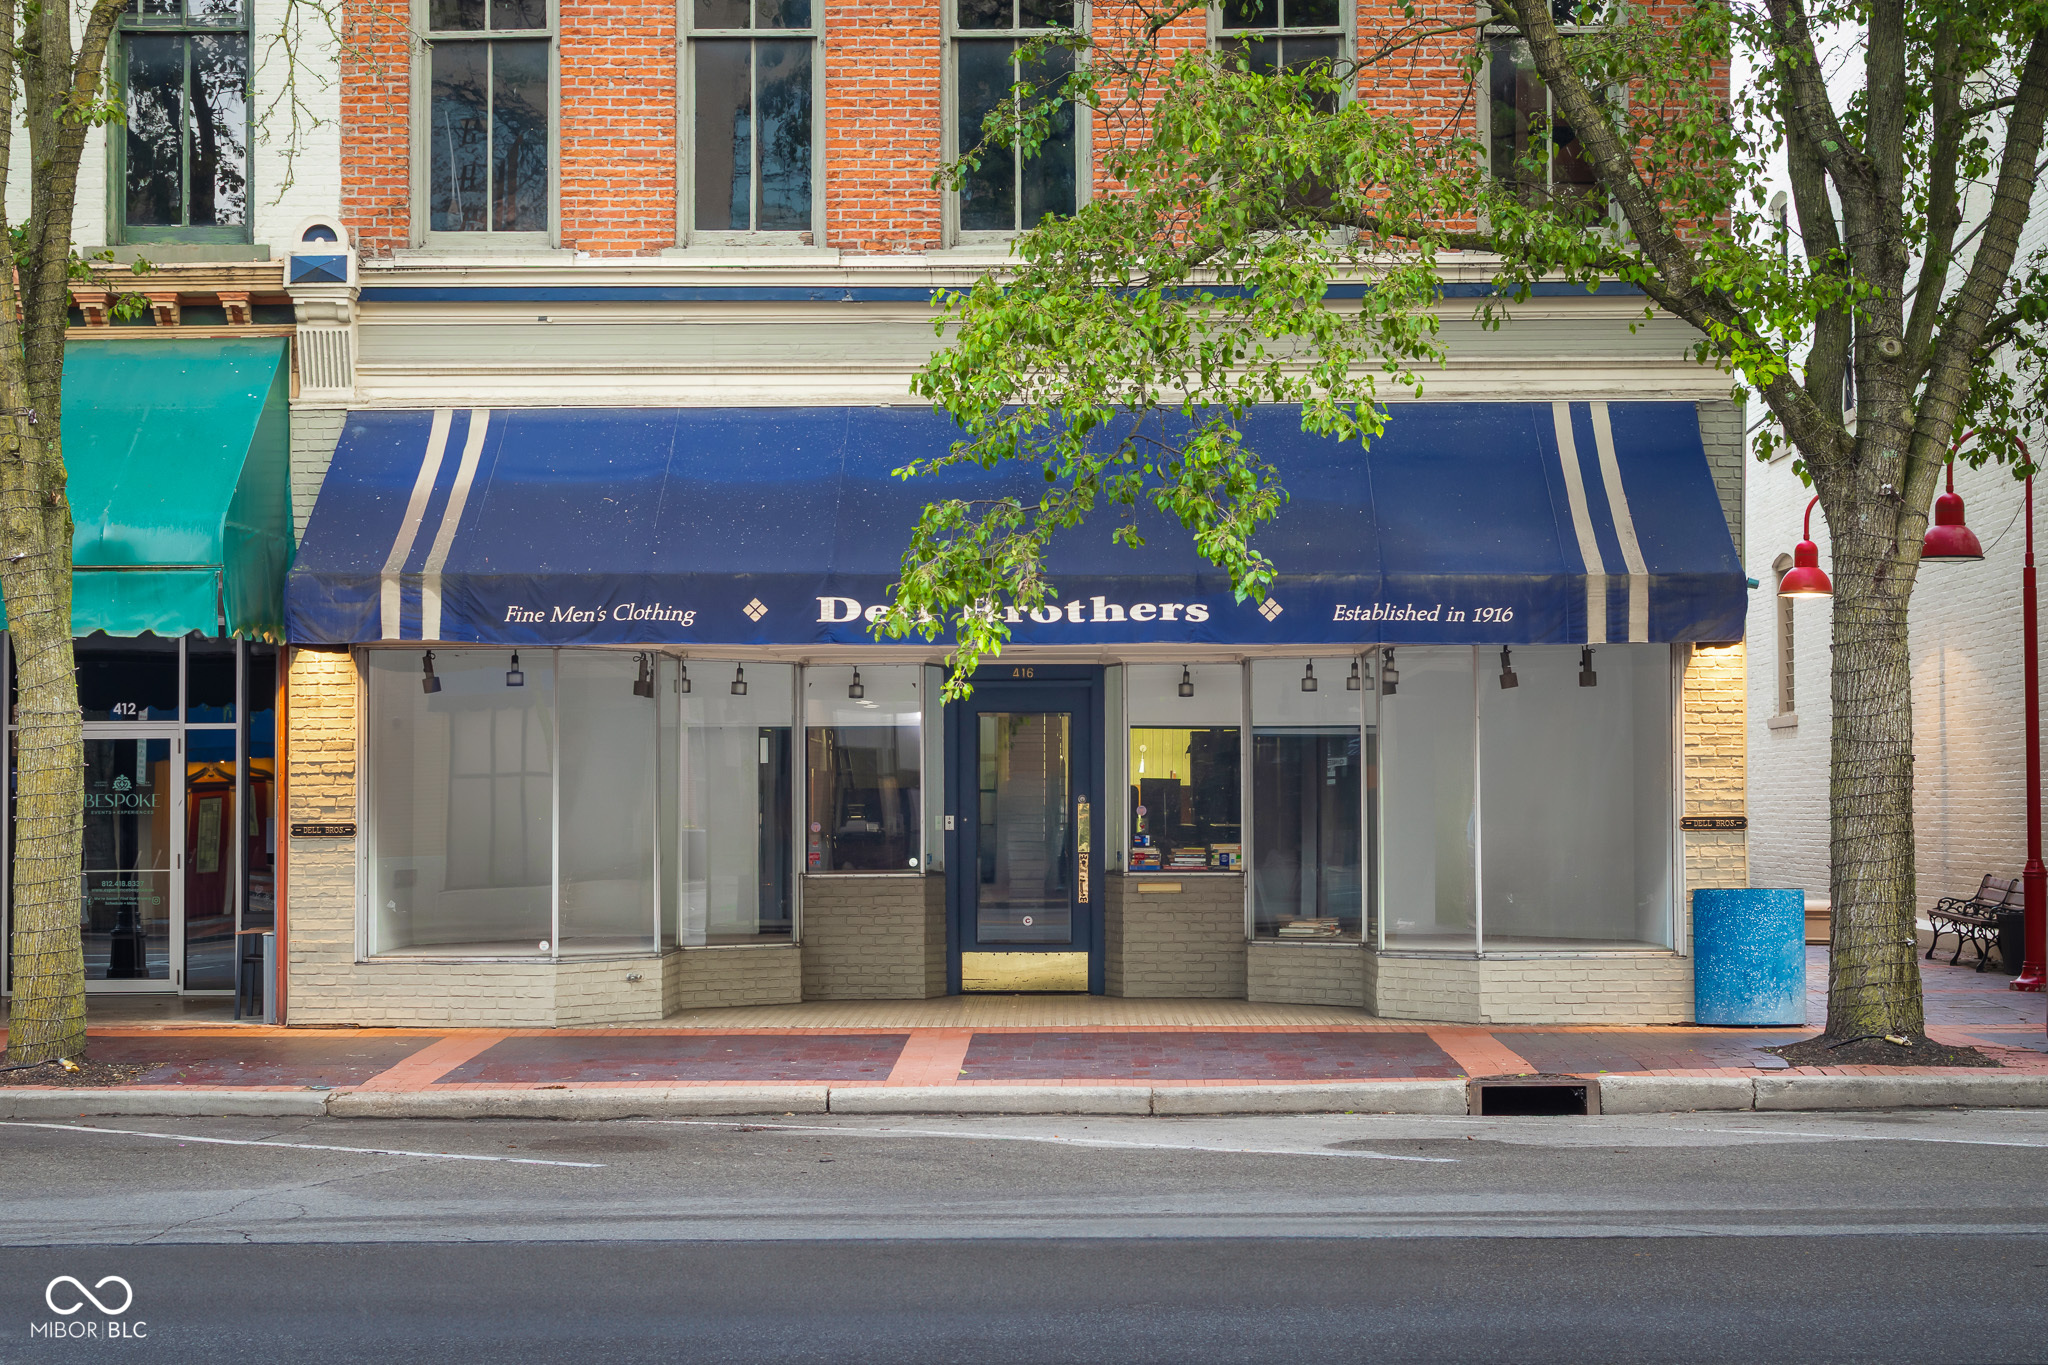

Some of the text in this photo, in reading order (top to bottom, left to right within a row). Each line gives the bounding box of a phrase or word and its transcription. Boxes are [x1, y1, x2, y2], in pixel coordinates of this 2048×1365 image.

[504, 603, 697, 627] Fine Men's Clothing
[815, 596, 932, 623] De
[1332, 603, 1514, 623] Established in 1916
[1012, 667, 1034, 679] 416
[113, 702, 136, 715] 412
[84, 793, 161, 808] BESPOKE
[303, 826, 346, 834] DELL BROS.
